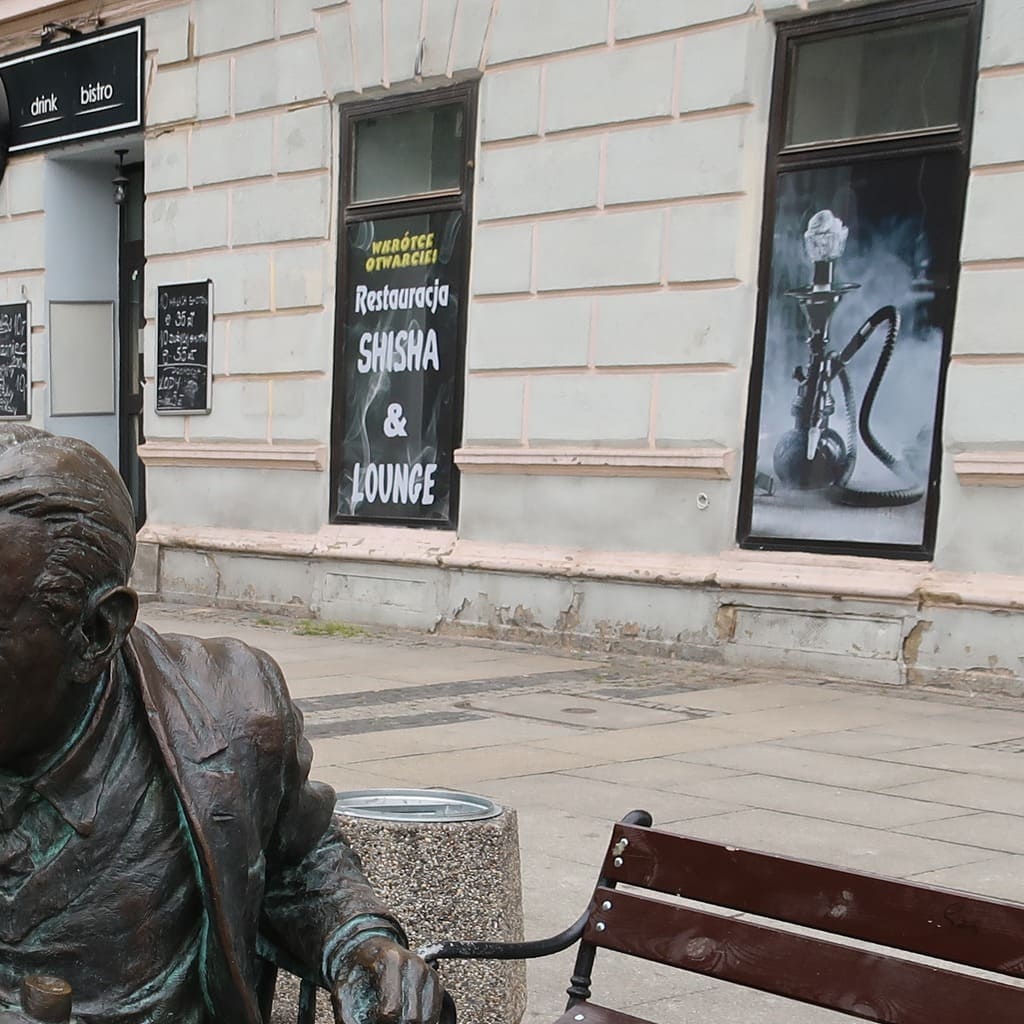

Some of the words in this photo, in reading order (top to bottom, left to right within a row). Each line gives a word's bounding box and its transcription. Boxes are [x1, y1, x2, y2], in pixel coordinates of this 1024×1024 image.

[31, 93, 59, 117] drink
[79, 81, 113, 105] bistro
[371, 231, 435, 256] WKRÓTCE
[355, 278, 449, 316] Restauracja
[357, 328, 440, 374] SHISHA
[383, 402, 408, 438] &
[351, 462, 438, 505] LOUNGE
